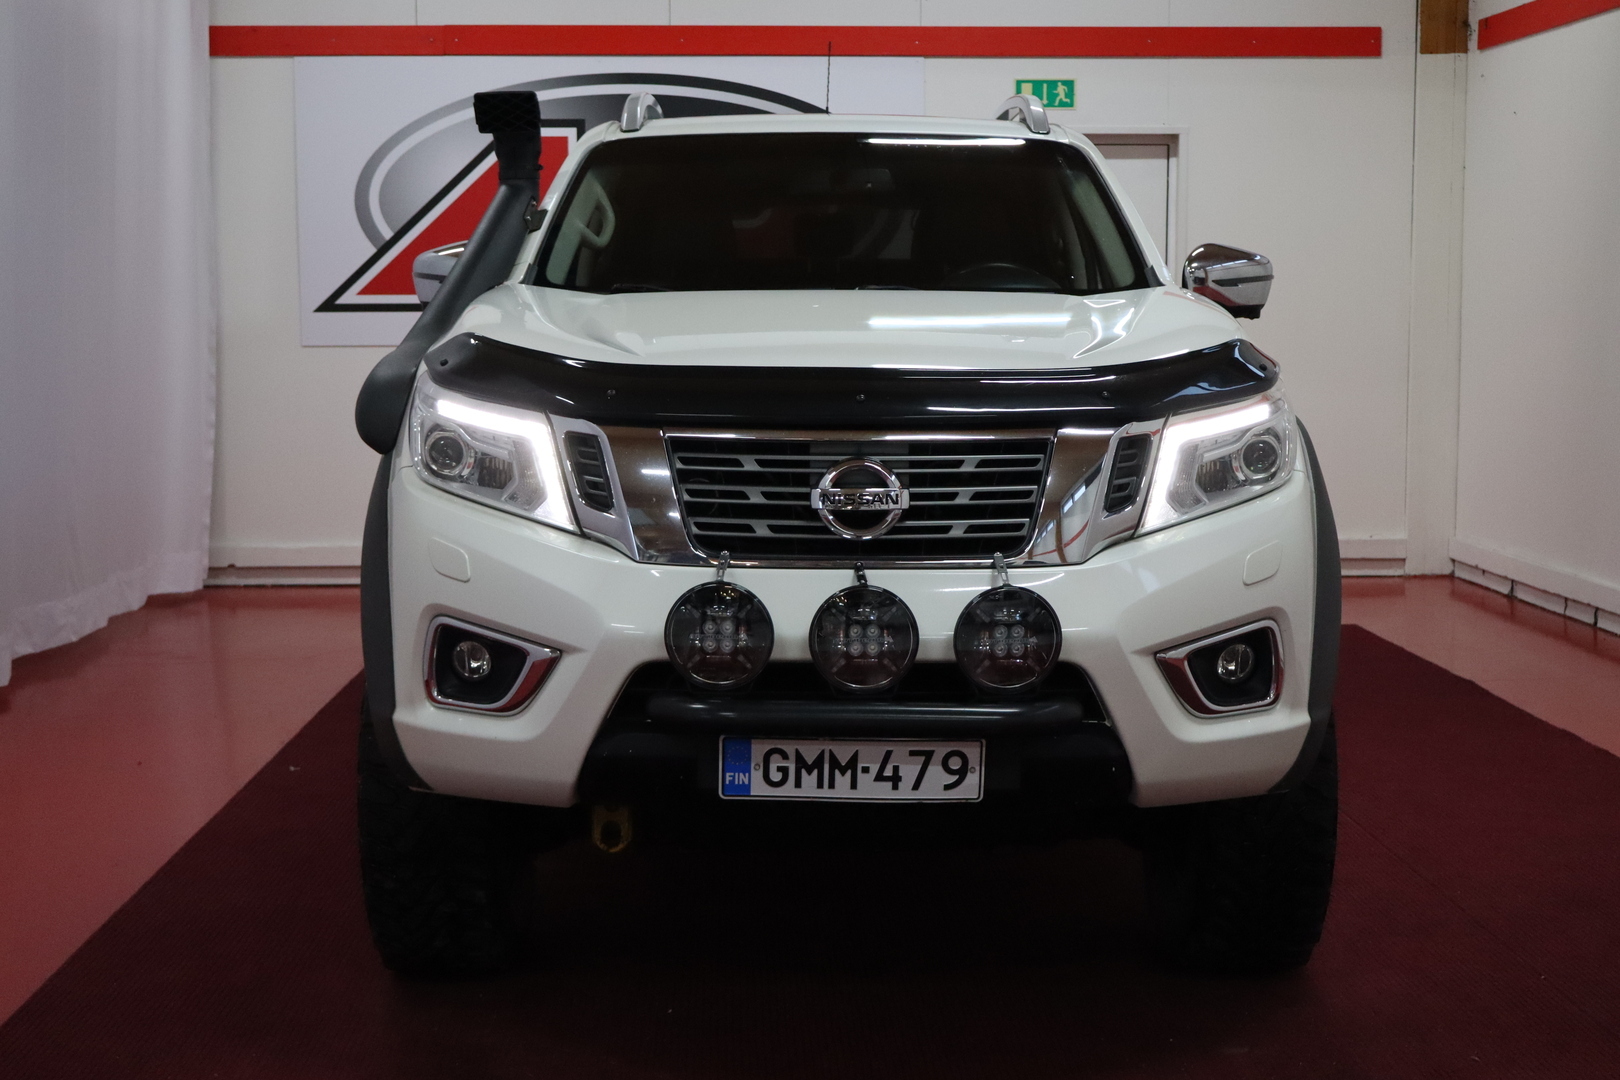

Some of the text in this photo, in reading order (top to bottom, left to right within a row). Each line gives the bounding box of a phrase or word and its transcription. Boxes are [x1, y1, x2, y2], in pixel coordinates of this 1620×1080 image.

[821, 493, 899, 505] NISSAN
[762, 747, 969, 791] GMM-479
[725, 772, 749, 785] FIN
